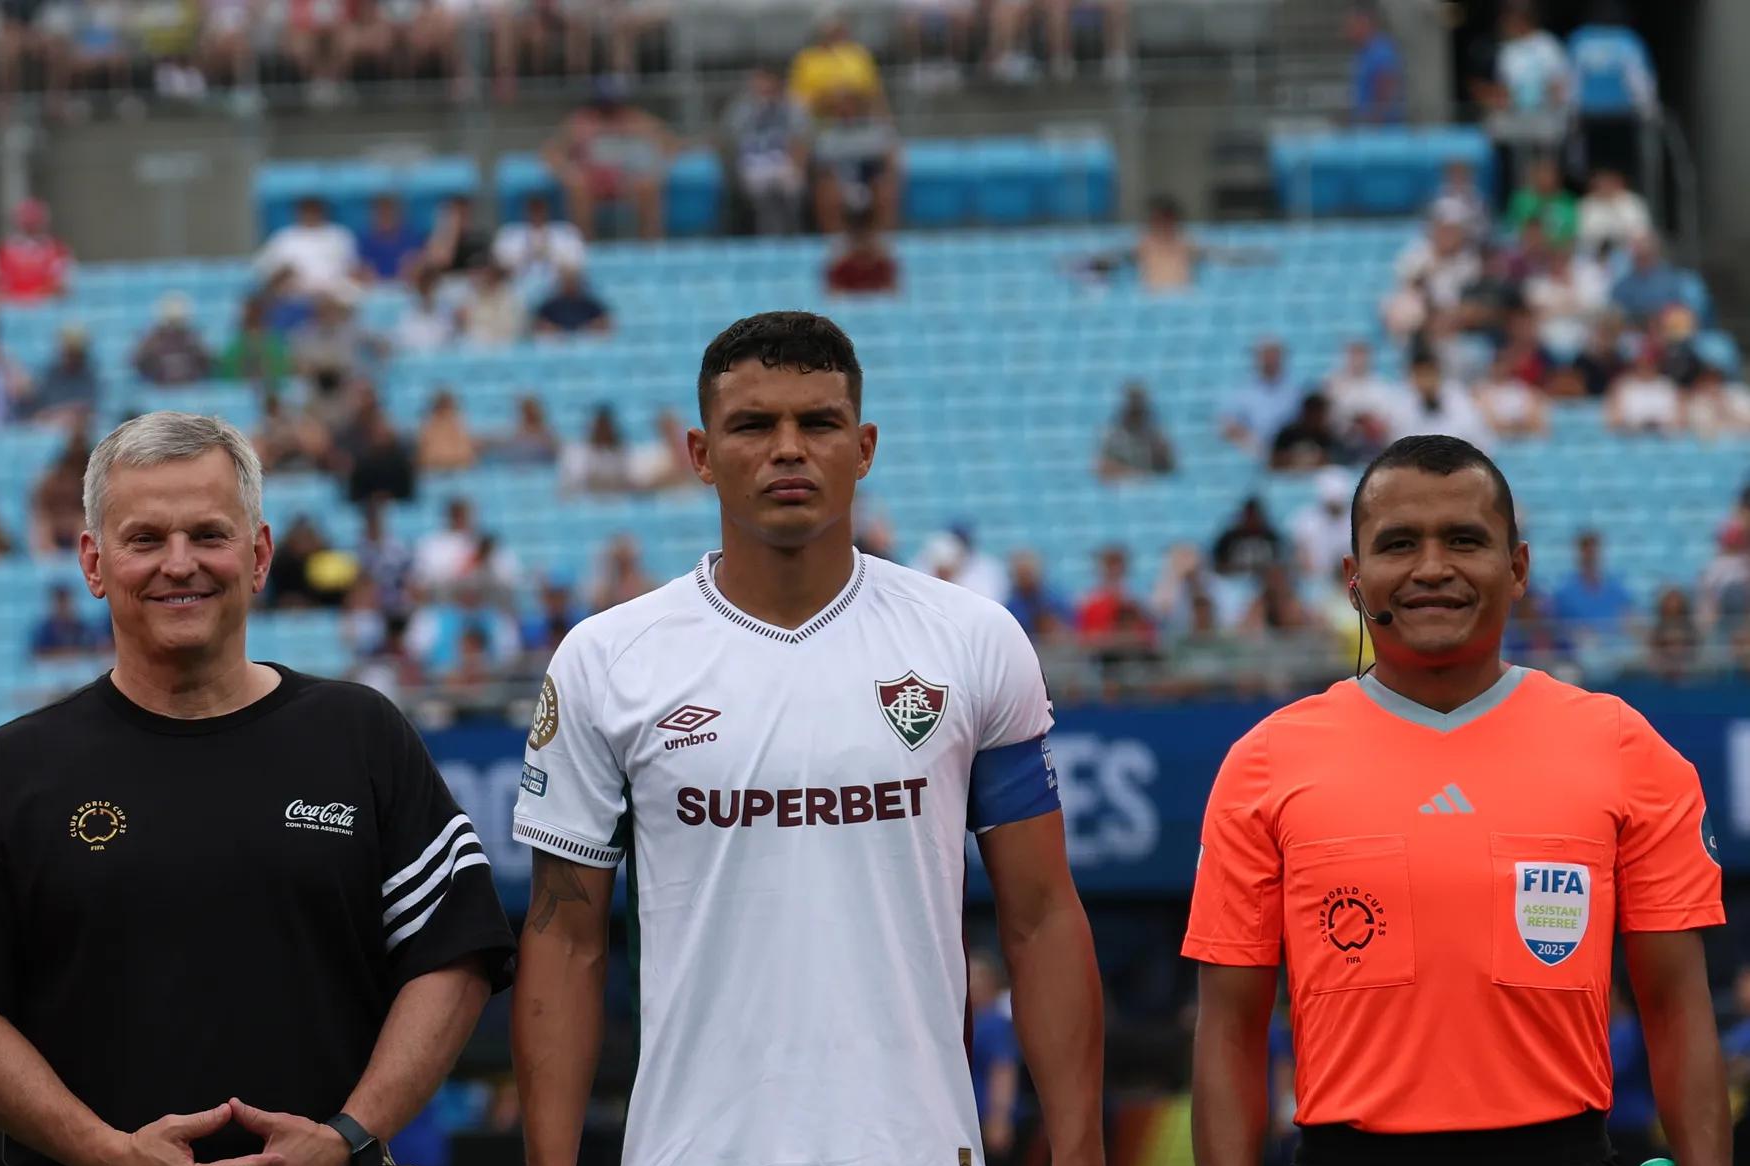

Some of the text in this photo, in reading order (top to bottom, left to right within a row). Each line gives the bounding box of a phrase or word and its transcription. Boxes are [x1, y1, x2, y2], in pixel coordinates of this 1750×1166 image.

[664, 732, 717, 750] umbro
[676, 777, 928, 828] SUPERBET
[1048, 732, 1161, 866] ES
[70, 815, 79, 838] CLUB
[77, 800, 111, 813] WORLD
[112, 806, 126, 820] CUP
[320, 825, 354, 836] ASSISTANT
[1523, 868, 1585, 895] FIFA
[1322, 886, 1359, 906] WORLD
[1364, 893, 1384, 915] CUP
[1377, 920, 1387, 937] 25
[1523, 904, 1583, 917] ASSISTANT
[1527, 916, 1578, 929] REFEREE
[1537, 943, 1566, 956] 2025
[1346, 956, 1362, 965] FIFA
